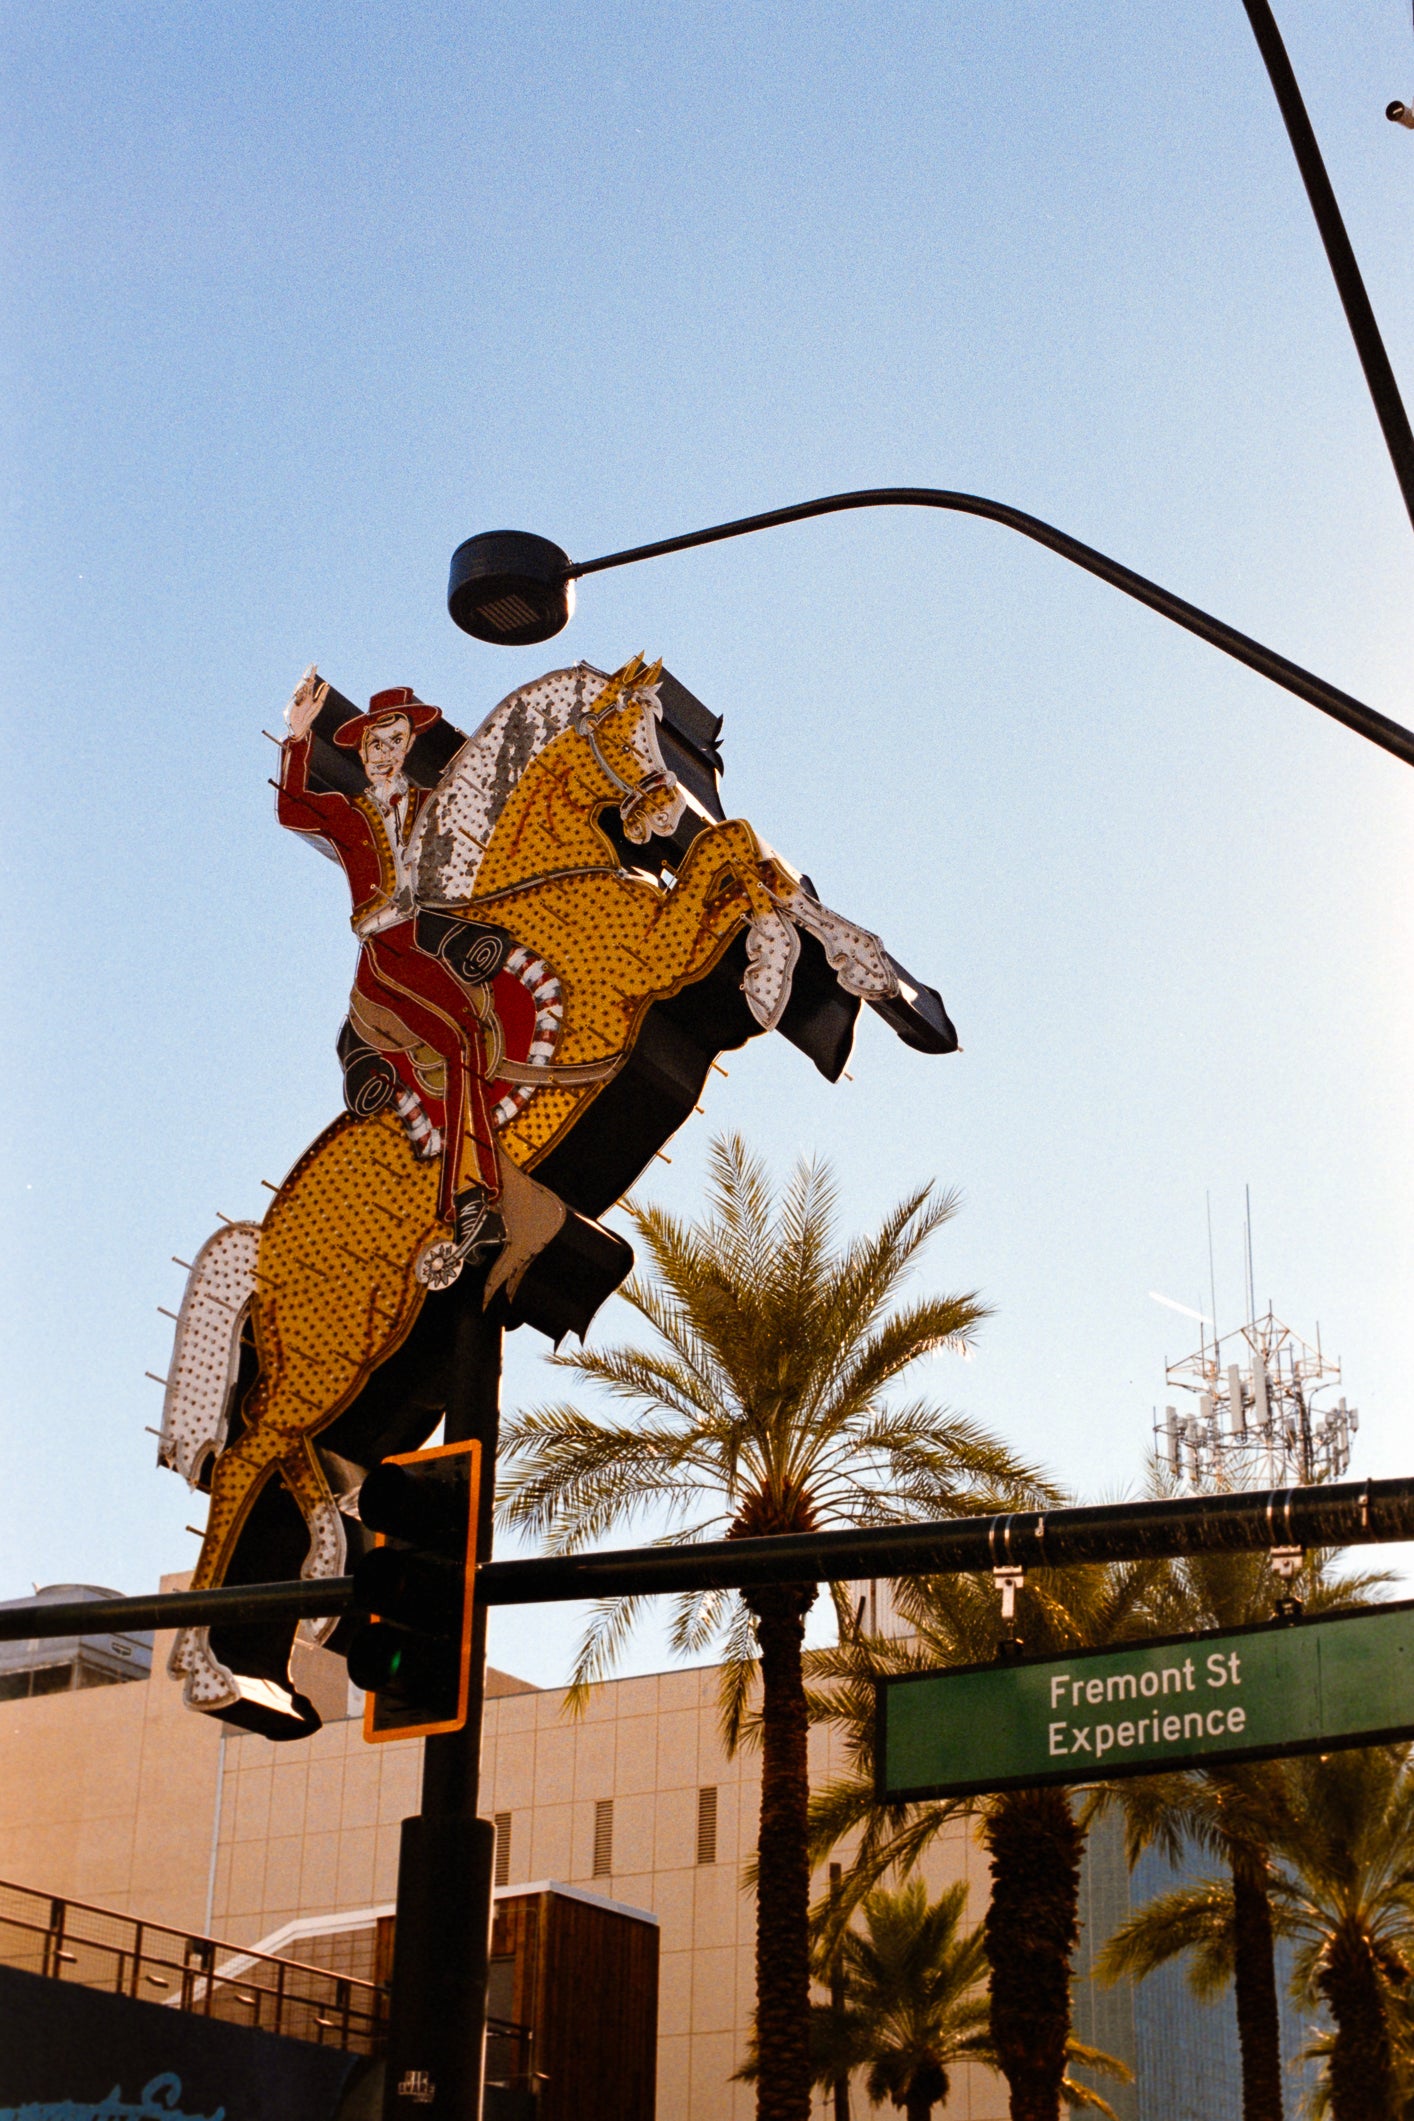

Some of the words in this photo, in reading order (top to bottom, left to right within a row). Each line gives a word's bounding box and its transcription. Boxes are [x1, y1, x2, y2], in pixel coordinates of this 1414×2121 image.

[1050, 1657, 1197, 1710] Fremont
[1206, 1651, 1243, 1688] St
[1048, 1706, 1246, 1758] Experience
